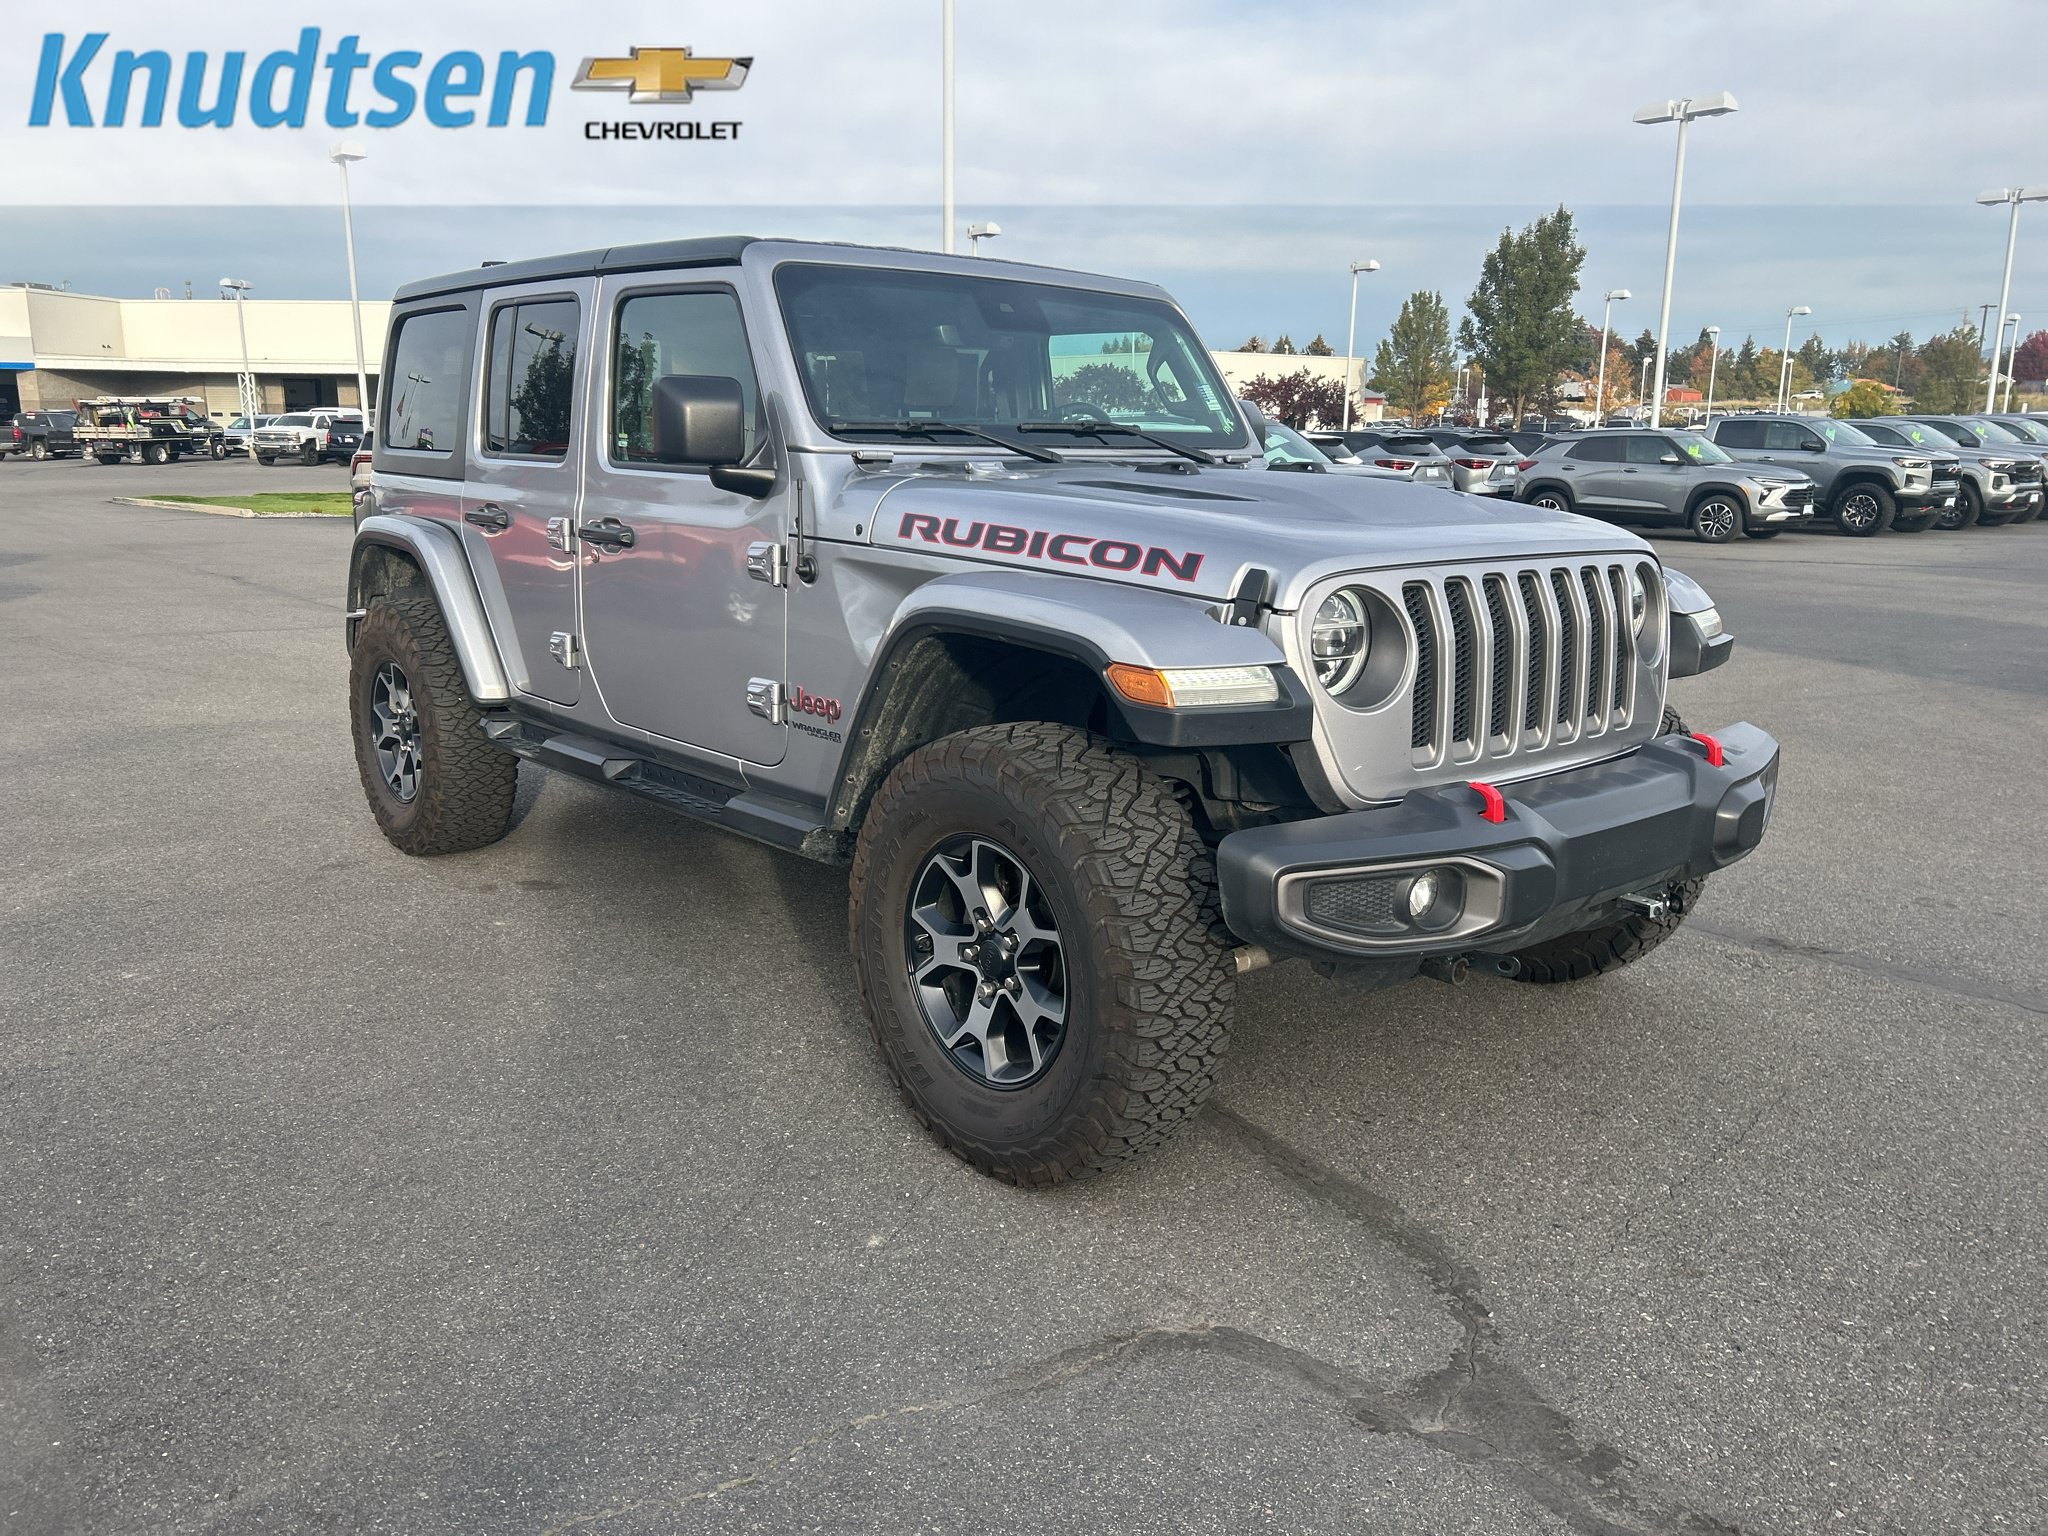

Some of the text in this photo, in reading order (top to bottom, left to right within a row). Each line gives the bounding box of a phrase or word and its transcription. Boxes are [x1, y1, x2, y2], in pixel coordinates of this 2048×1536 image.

[898, 513, 1205, 582] RUBICON
[789, 686, 842, 724] Jeep
[792, 721, 842, 740] WRANGLER
[807, 732, 842, 743] UNLIMITED
[869, 834, 934, 1090] BFGoodrich
